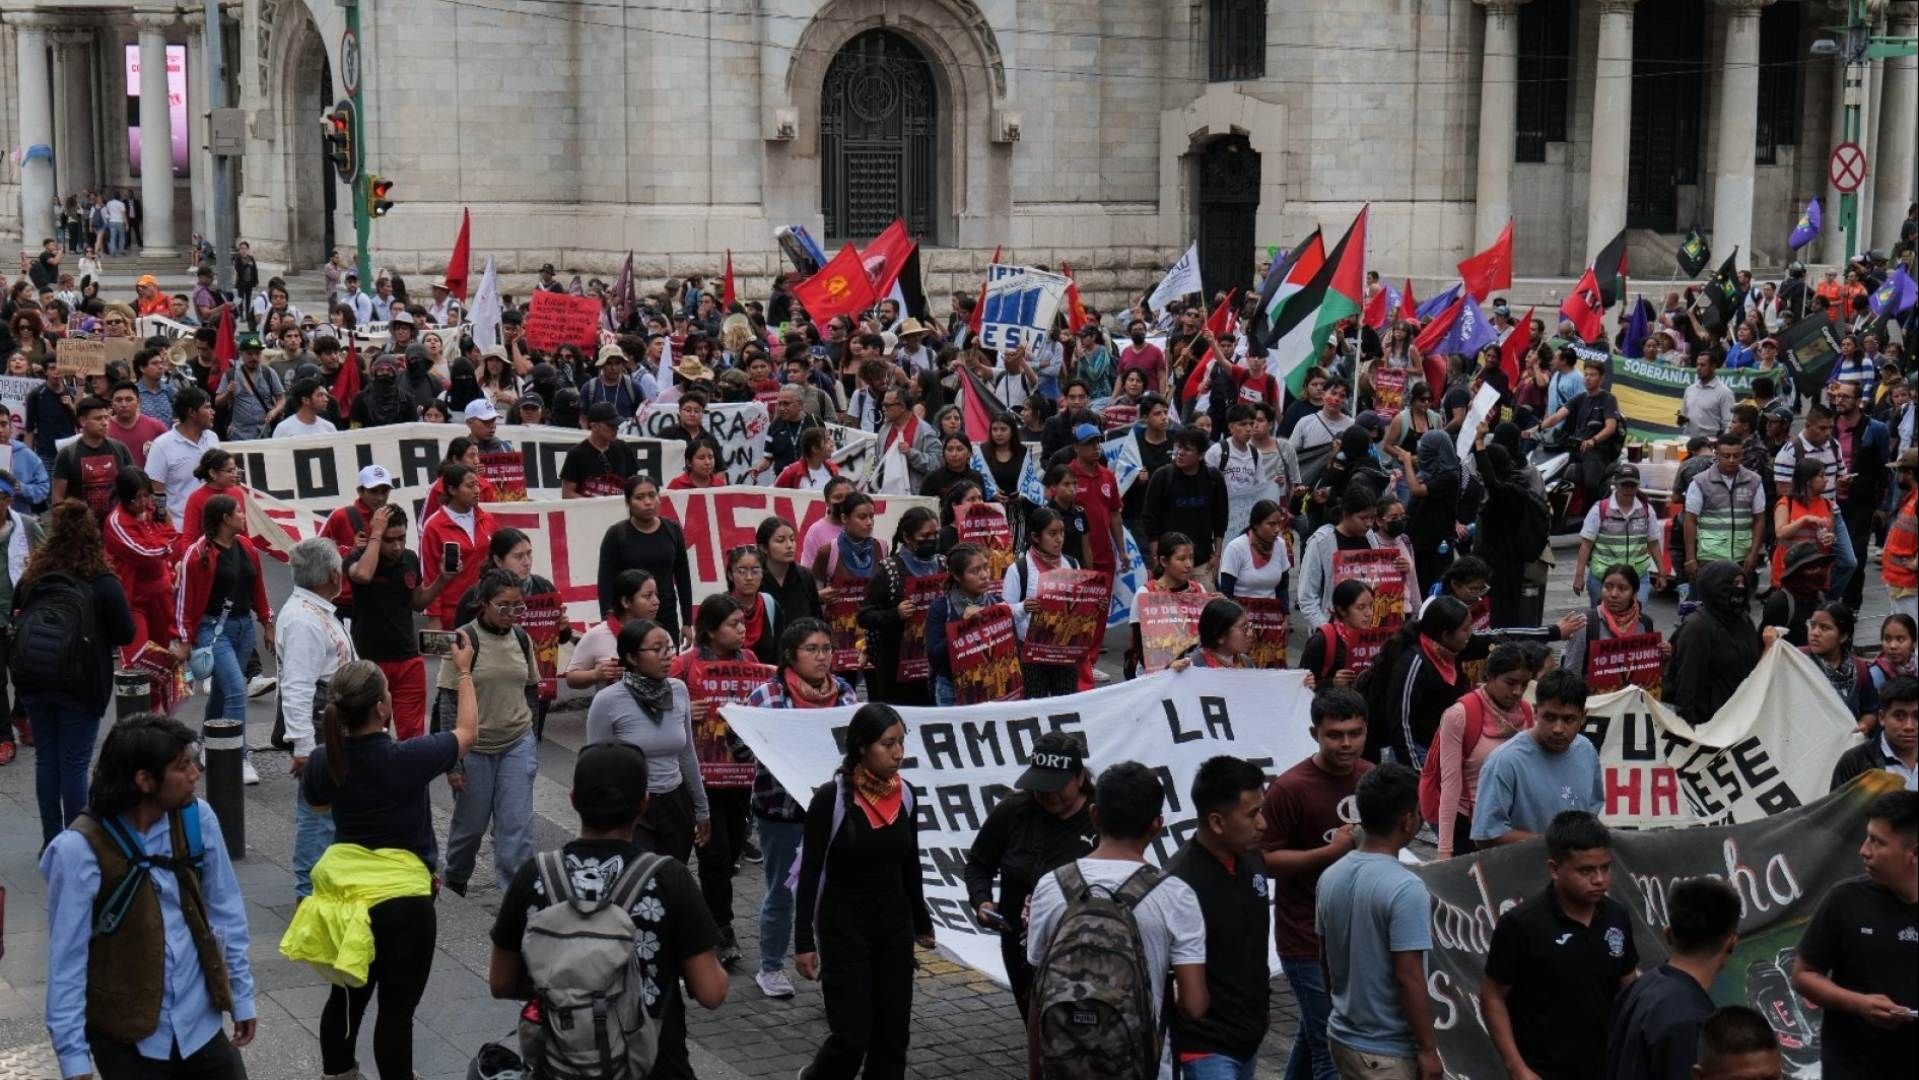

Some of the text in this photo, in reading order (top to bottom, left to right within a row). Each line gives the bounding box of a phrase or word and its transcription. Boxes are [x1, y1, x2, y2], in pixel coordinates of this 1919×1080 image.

[1623, 358, 1690, 385] SOBERANÍA
[1041, 581, 1107, 595] 10 DE JUNIO
[1144, 606, 1158, 615] 10
[1160, 605, 1177, 614] DE
[953, 618, 1013, 649] 10 DE JUNIO
[1352, 647, 1366, 656] 10
[1594, 656, 1607, 666] 10
[1610, 653, 1625, 664] DE
[703, 679, 717, 690] 10
[721, 680, 738, 691] DE
[1162, 696, 1234, 744] LA
